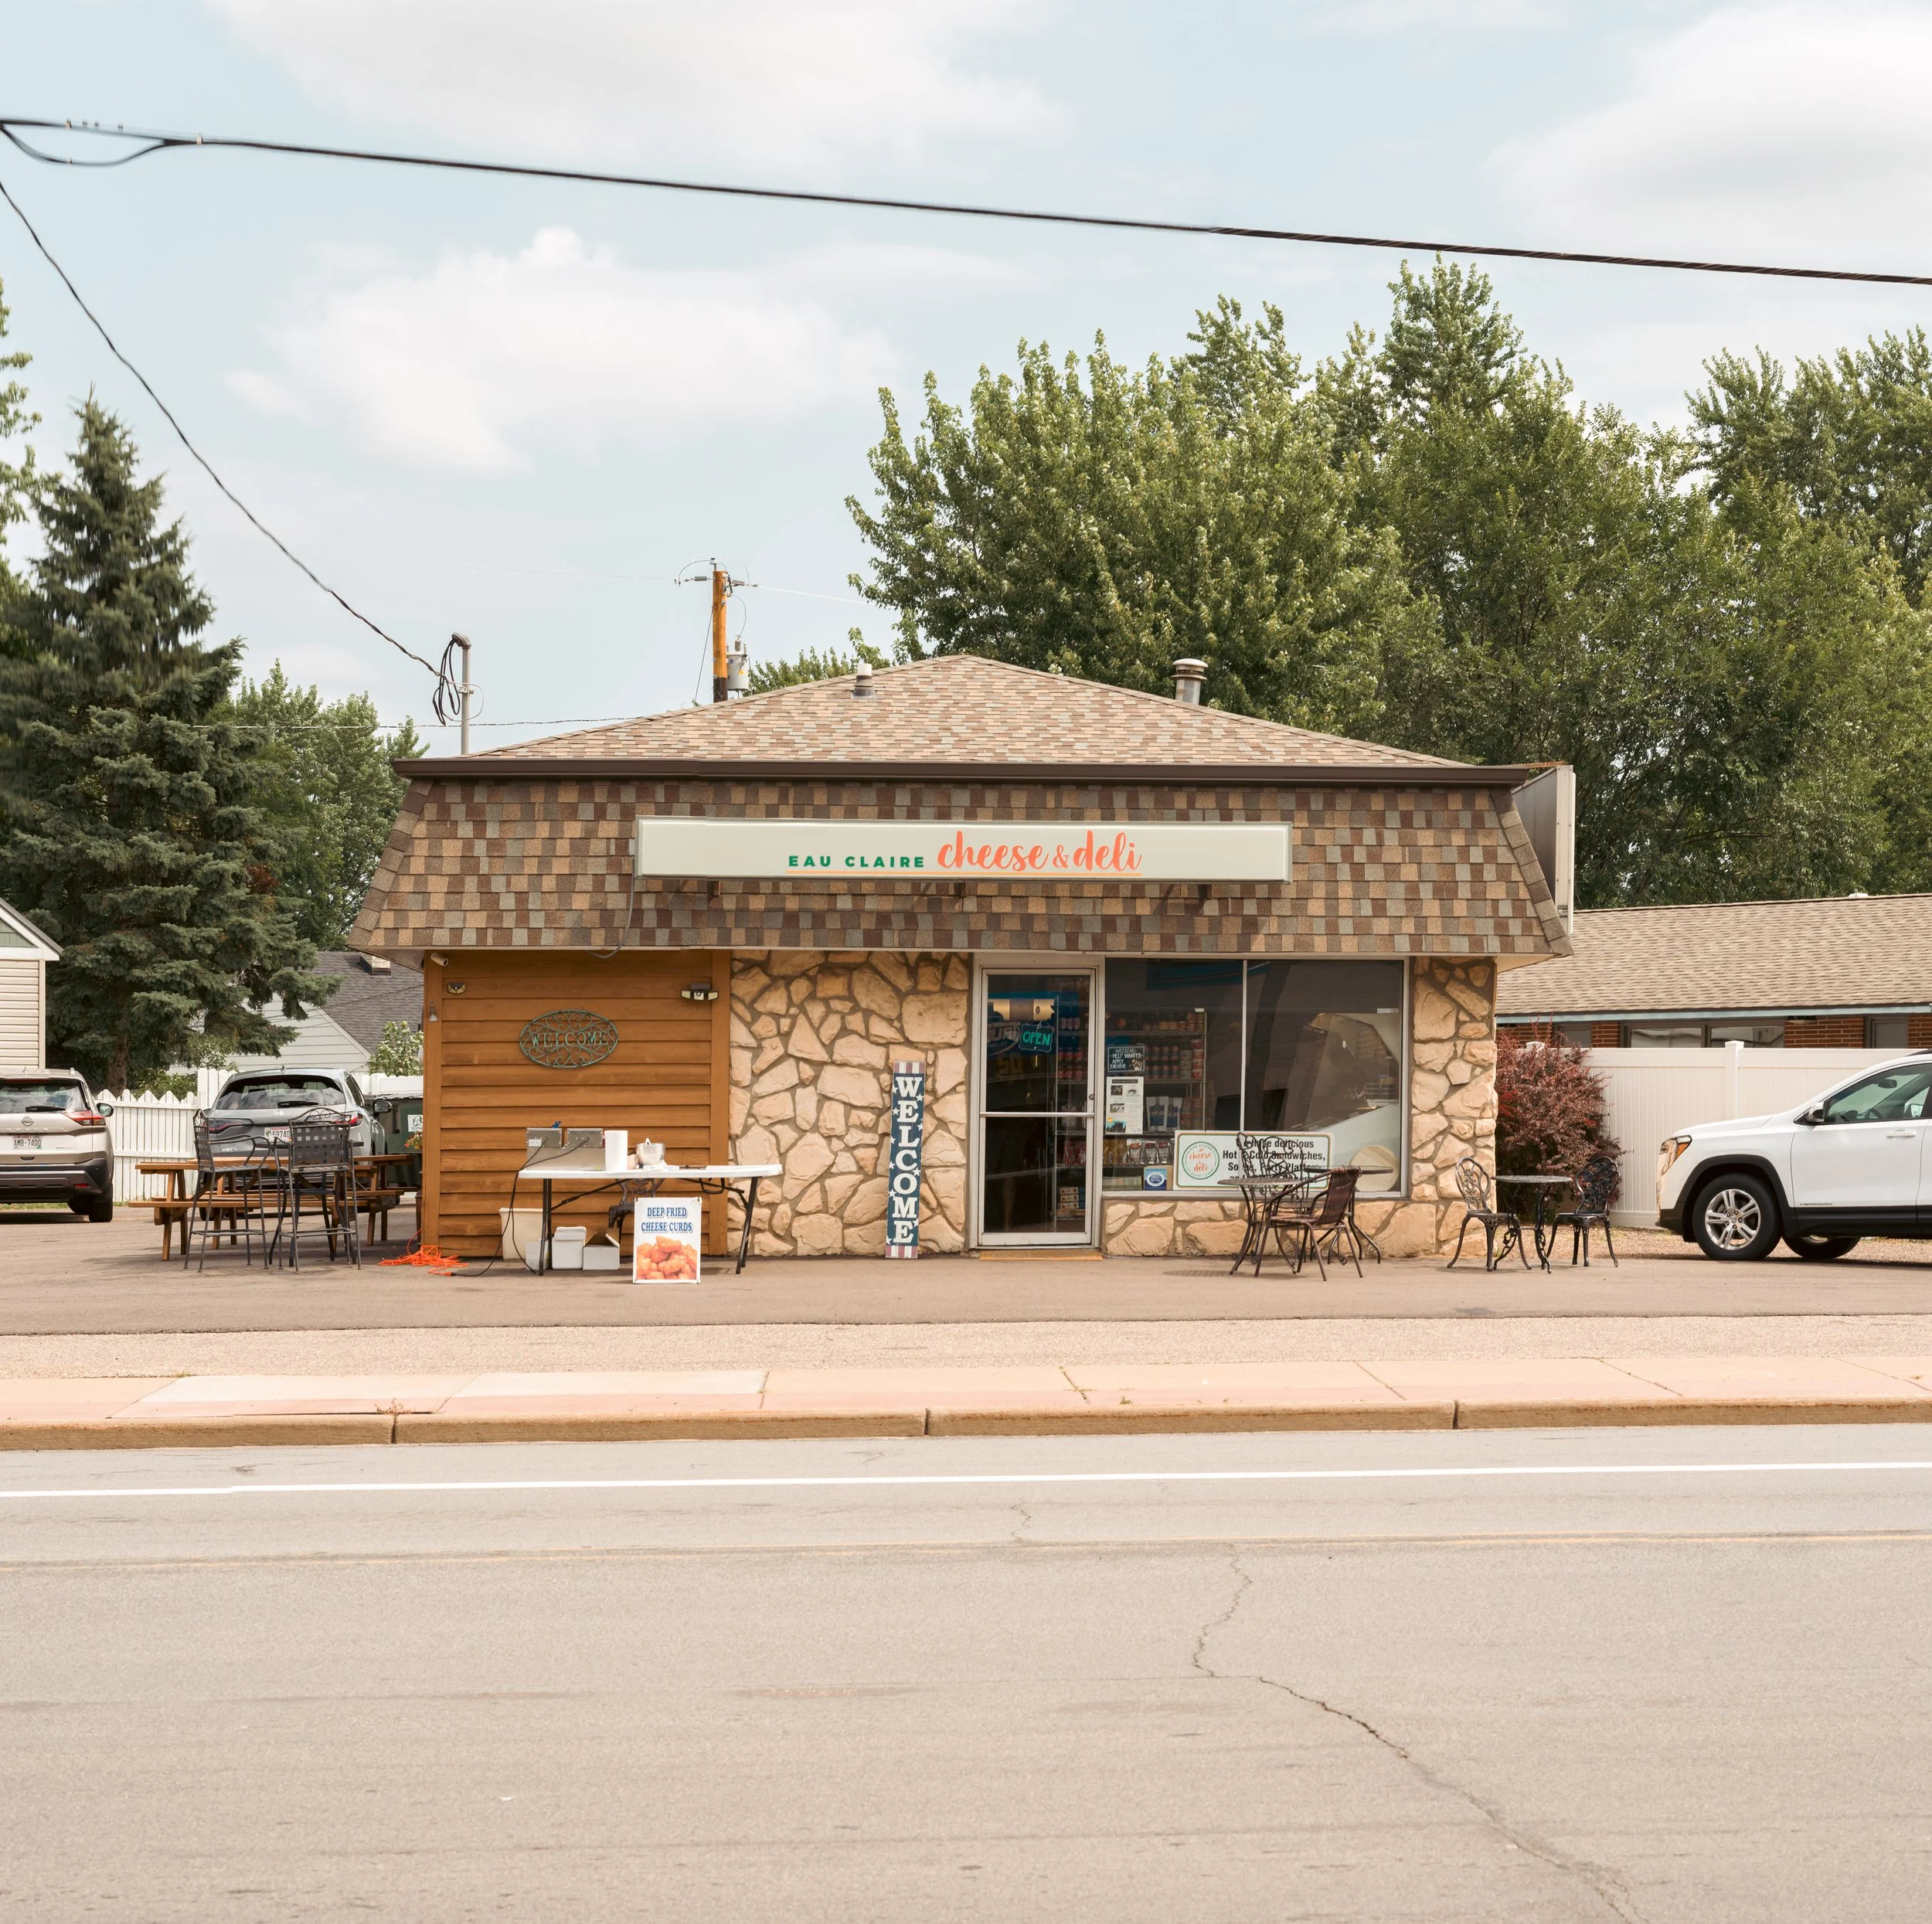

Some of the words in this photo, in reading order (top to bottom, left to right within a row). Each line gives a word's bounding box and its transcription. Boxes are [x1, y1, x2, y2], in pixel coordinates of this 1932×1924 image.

[788, 855, 832, 867] EAU
[845, 855, 924, 868] CLAIRE
[937, 830, 1049, 872] cheese
[1053, 845, 1070, 869] &
[1073, 830, 1142, 872] deli
[530, 1032, 608, 1047] WELCOME
[1022, 1031, 1051, 1046] OPEN
[1274, 1138, 1315, 1148] delicious
[892, 1076, 923, 1243] WELCOME
[1223, 1150, 1237, 1159] Hot
[1271, 1150, 1326, 1161] Sandwiches,
[647, 1207, 665, 1218] DEEP
[666, 1207, 687, 1218] FRIED
[641, 1222, 668, 1232] CHEESE
[669, 1222, 693, 1232] CURDS
